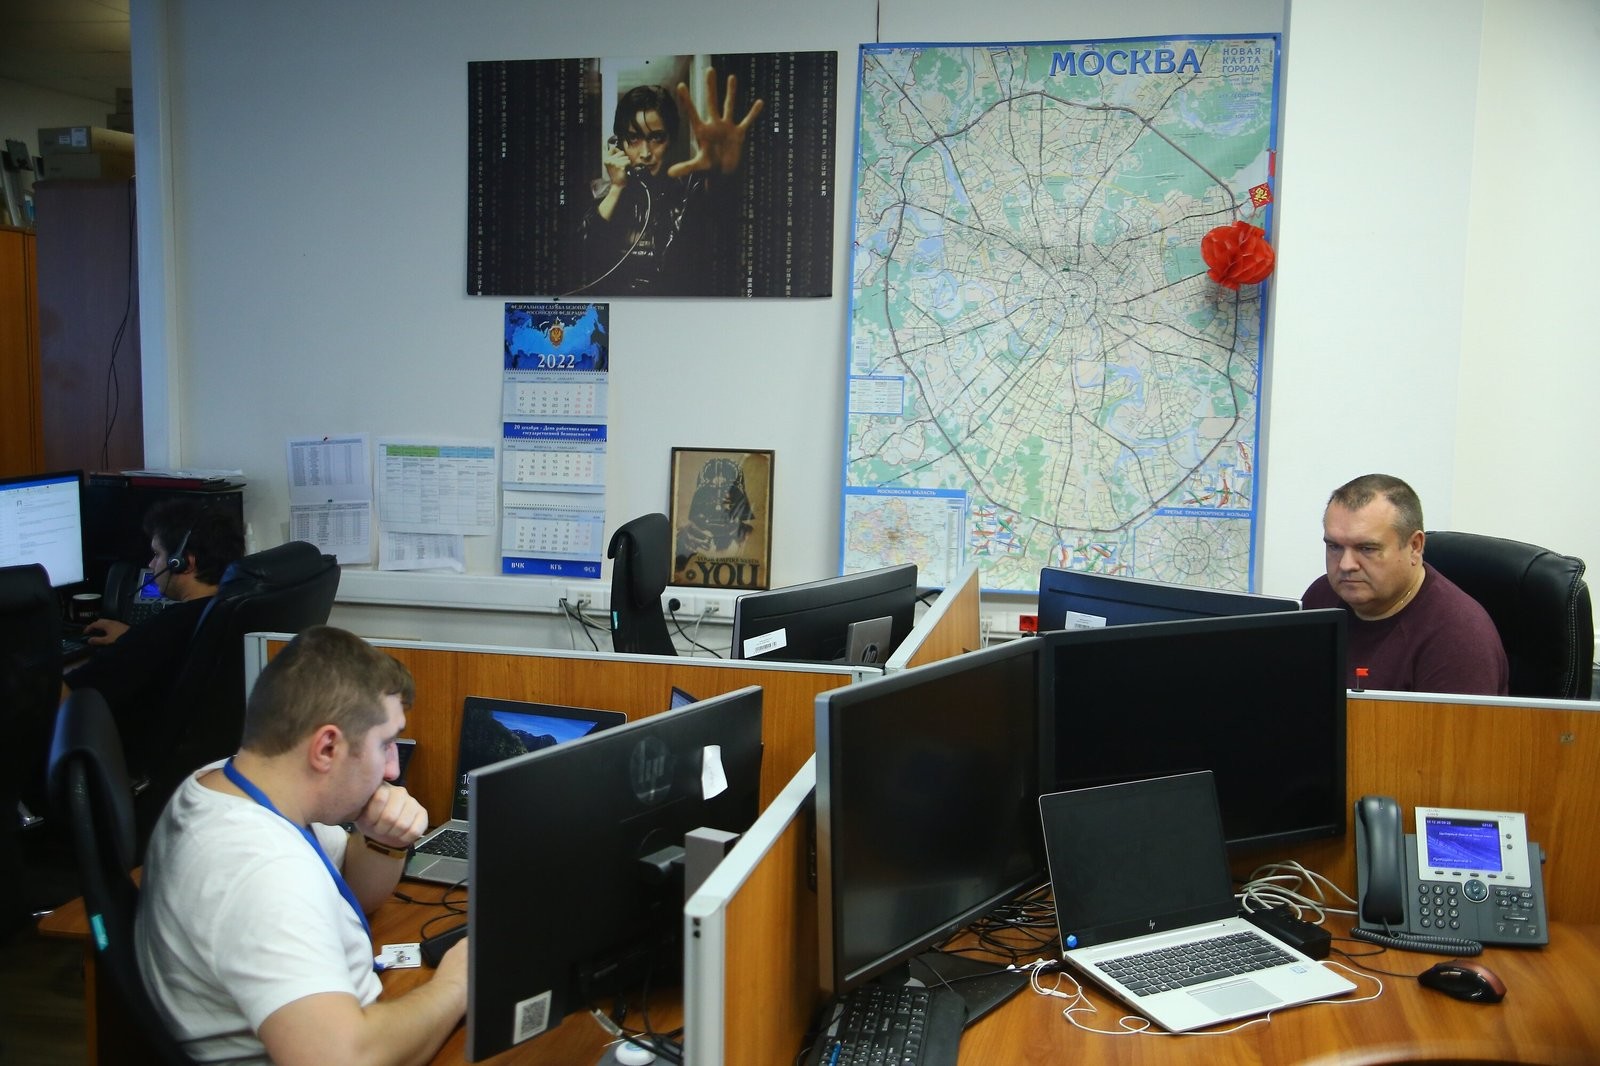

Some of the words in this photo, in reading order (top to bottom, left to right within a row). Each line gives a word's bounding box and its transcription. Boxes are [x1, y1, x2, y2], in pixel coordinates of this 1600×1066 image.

[1222, 48, 1261, 56] НОВАЯ
[1050, 48, 1202, 76] МОСКВА
[1222, 56, 1261, 64] КАРТА
[1222, 65, 1260, 73] ГОРОДА
[538, 354, 575, 368] 2022
[696, 561, 760, 586] YOU
